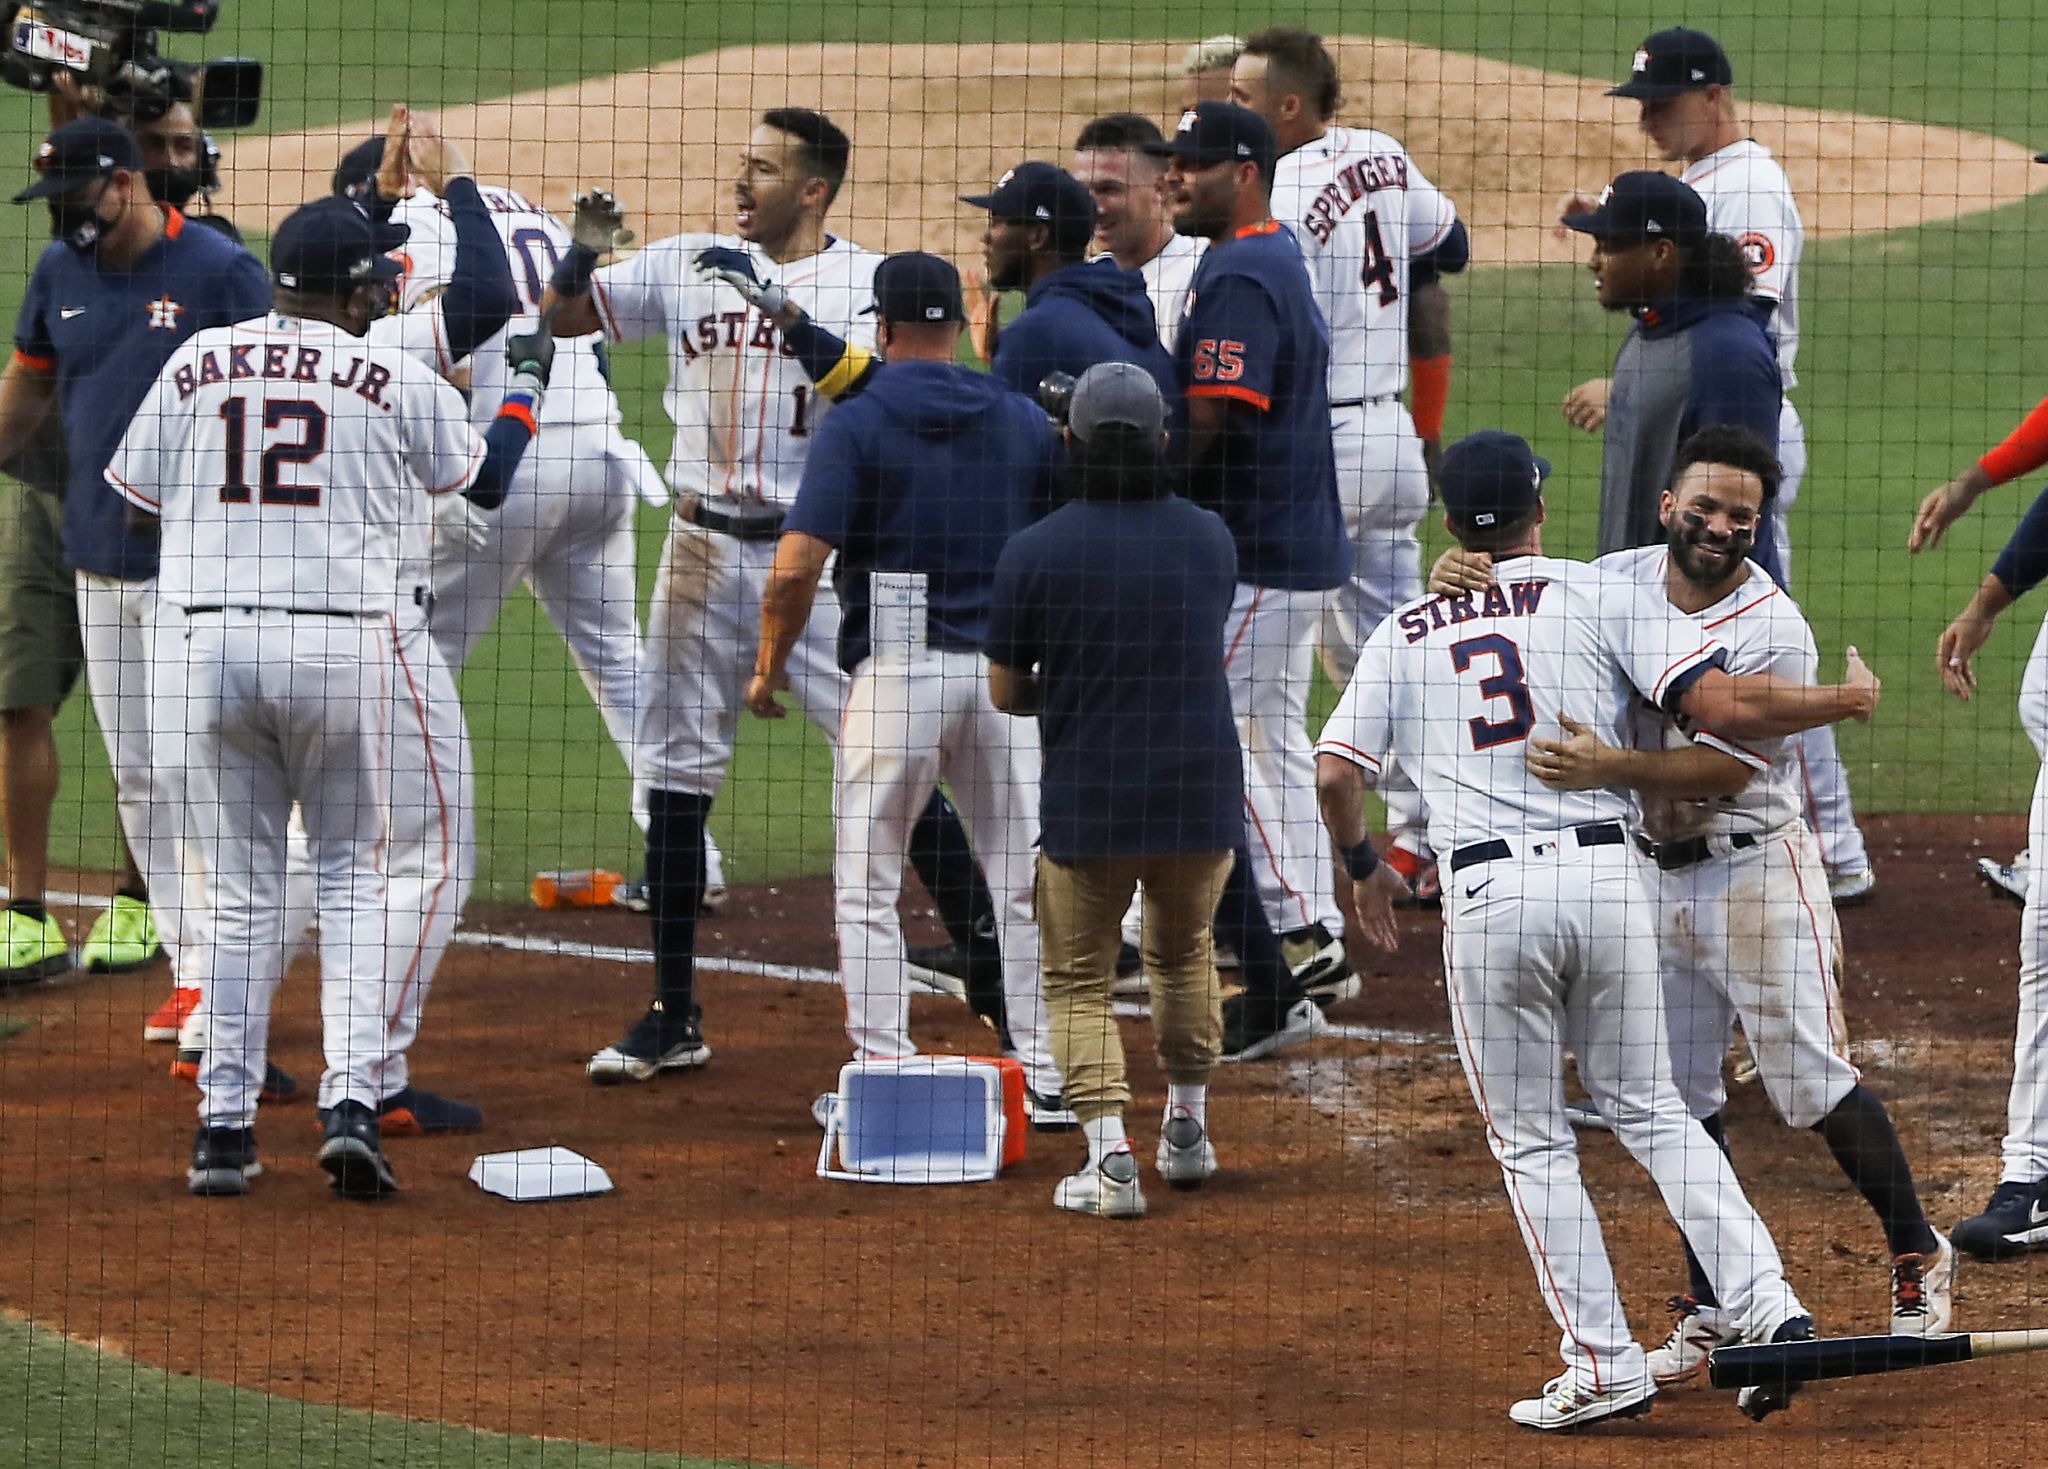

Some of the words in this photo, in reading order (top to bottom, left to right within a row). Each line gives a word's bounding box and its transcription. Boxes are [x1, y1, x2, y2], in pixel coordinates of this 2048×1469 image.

[1304, 155, 1408, 248] SPRIGER
[1362, 209, 1399, 308] 4
[174, 343, 322, 400] BAKER
[332, 357, 392, 412] JR.
[1194, 339, 1246, 381] 65
[218, 396, 326, 506] 12
[1398, 580, 1549, 644] STRAW
[1449, 632, 1536, 751] 3
